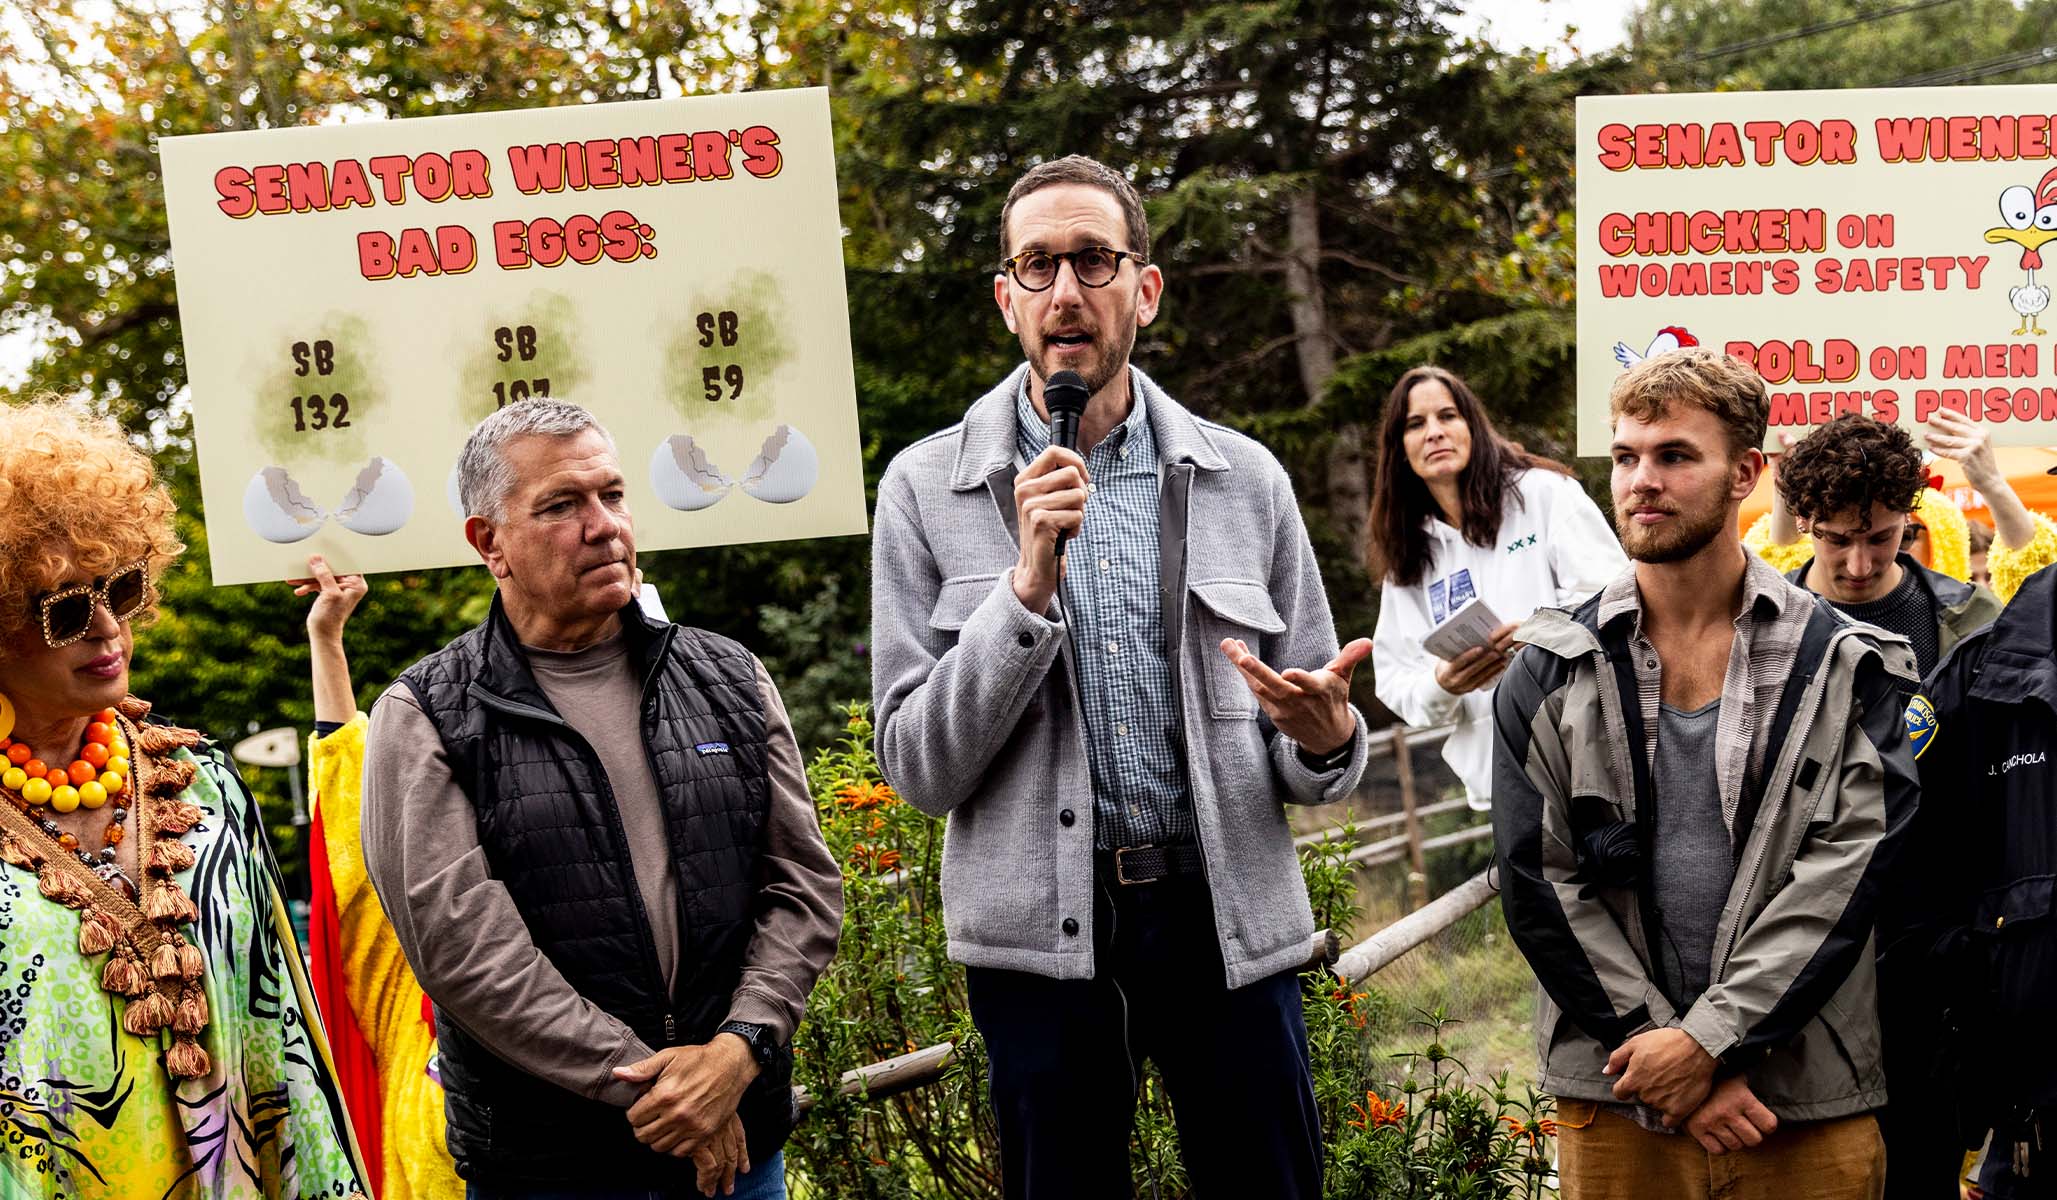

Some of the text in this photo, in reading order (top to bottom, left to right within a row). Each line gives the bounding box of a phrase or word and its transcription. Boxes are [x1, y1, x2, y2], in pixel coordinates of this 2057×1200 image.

[1598, 114, 2057, 172] SENATOR WIENE
[214, 125, 783, 219] SENATOR WIENER'S
[357, 210, 658, 281] BAD EGGS:
[1598, 208, 1895, 258] CHICKEN ON
[1598, 255, 1990, 298] WOMEN'S SAFETY
[494, 325, 536, 362] SB
[696, 311, 738, 348] SB
[291, 340, 334, 377] SB
[1870, 346, 1927, 380] ON
[1943, 343, 2038, 378] MEN
[702, 364, 744, 401] 59
[290, 393, 351, 432] 132
[1988, 751, 2046, 776] J. CANCHOLA
